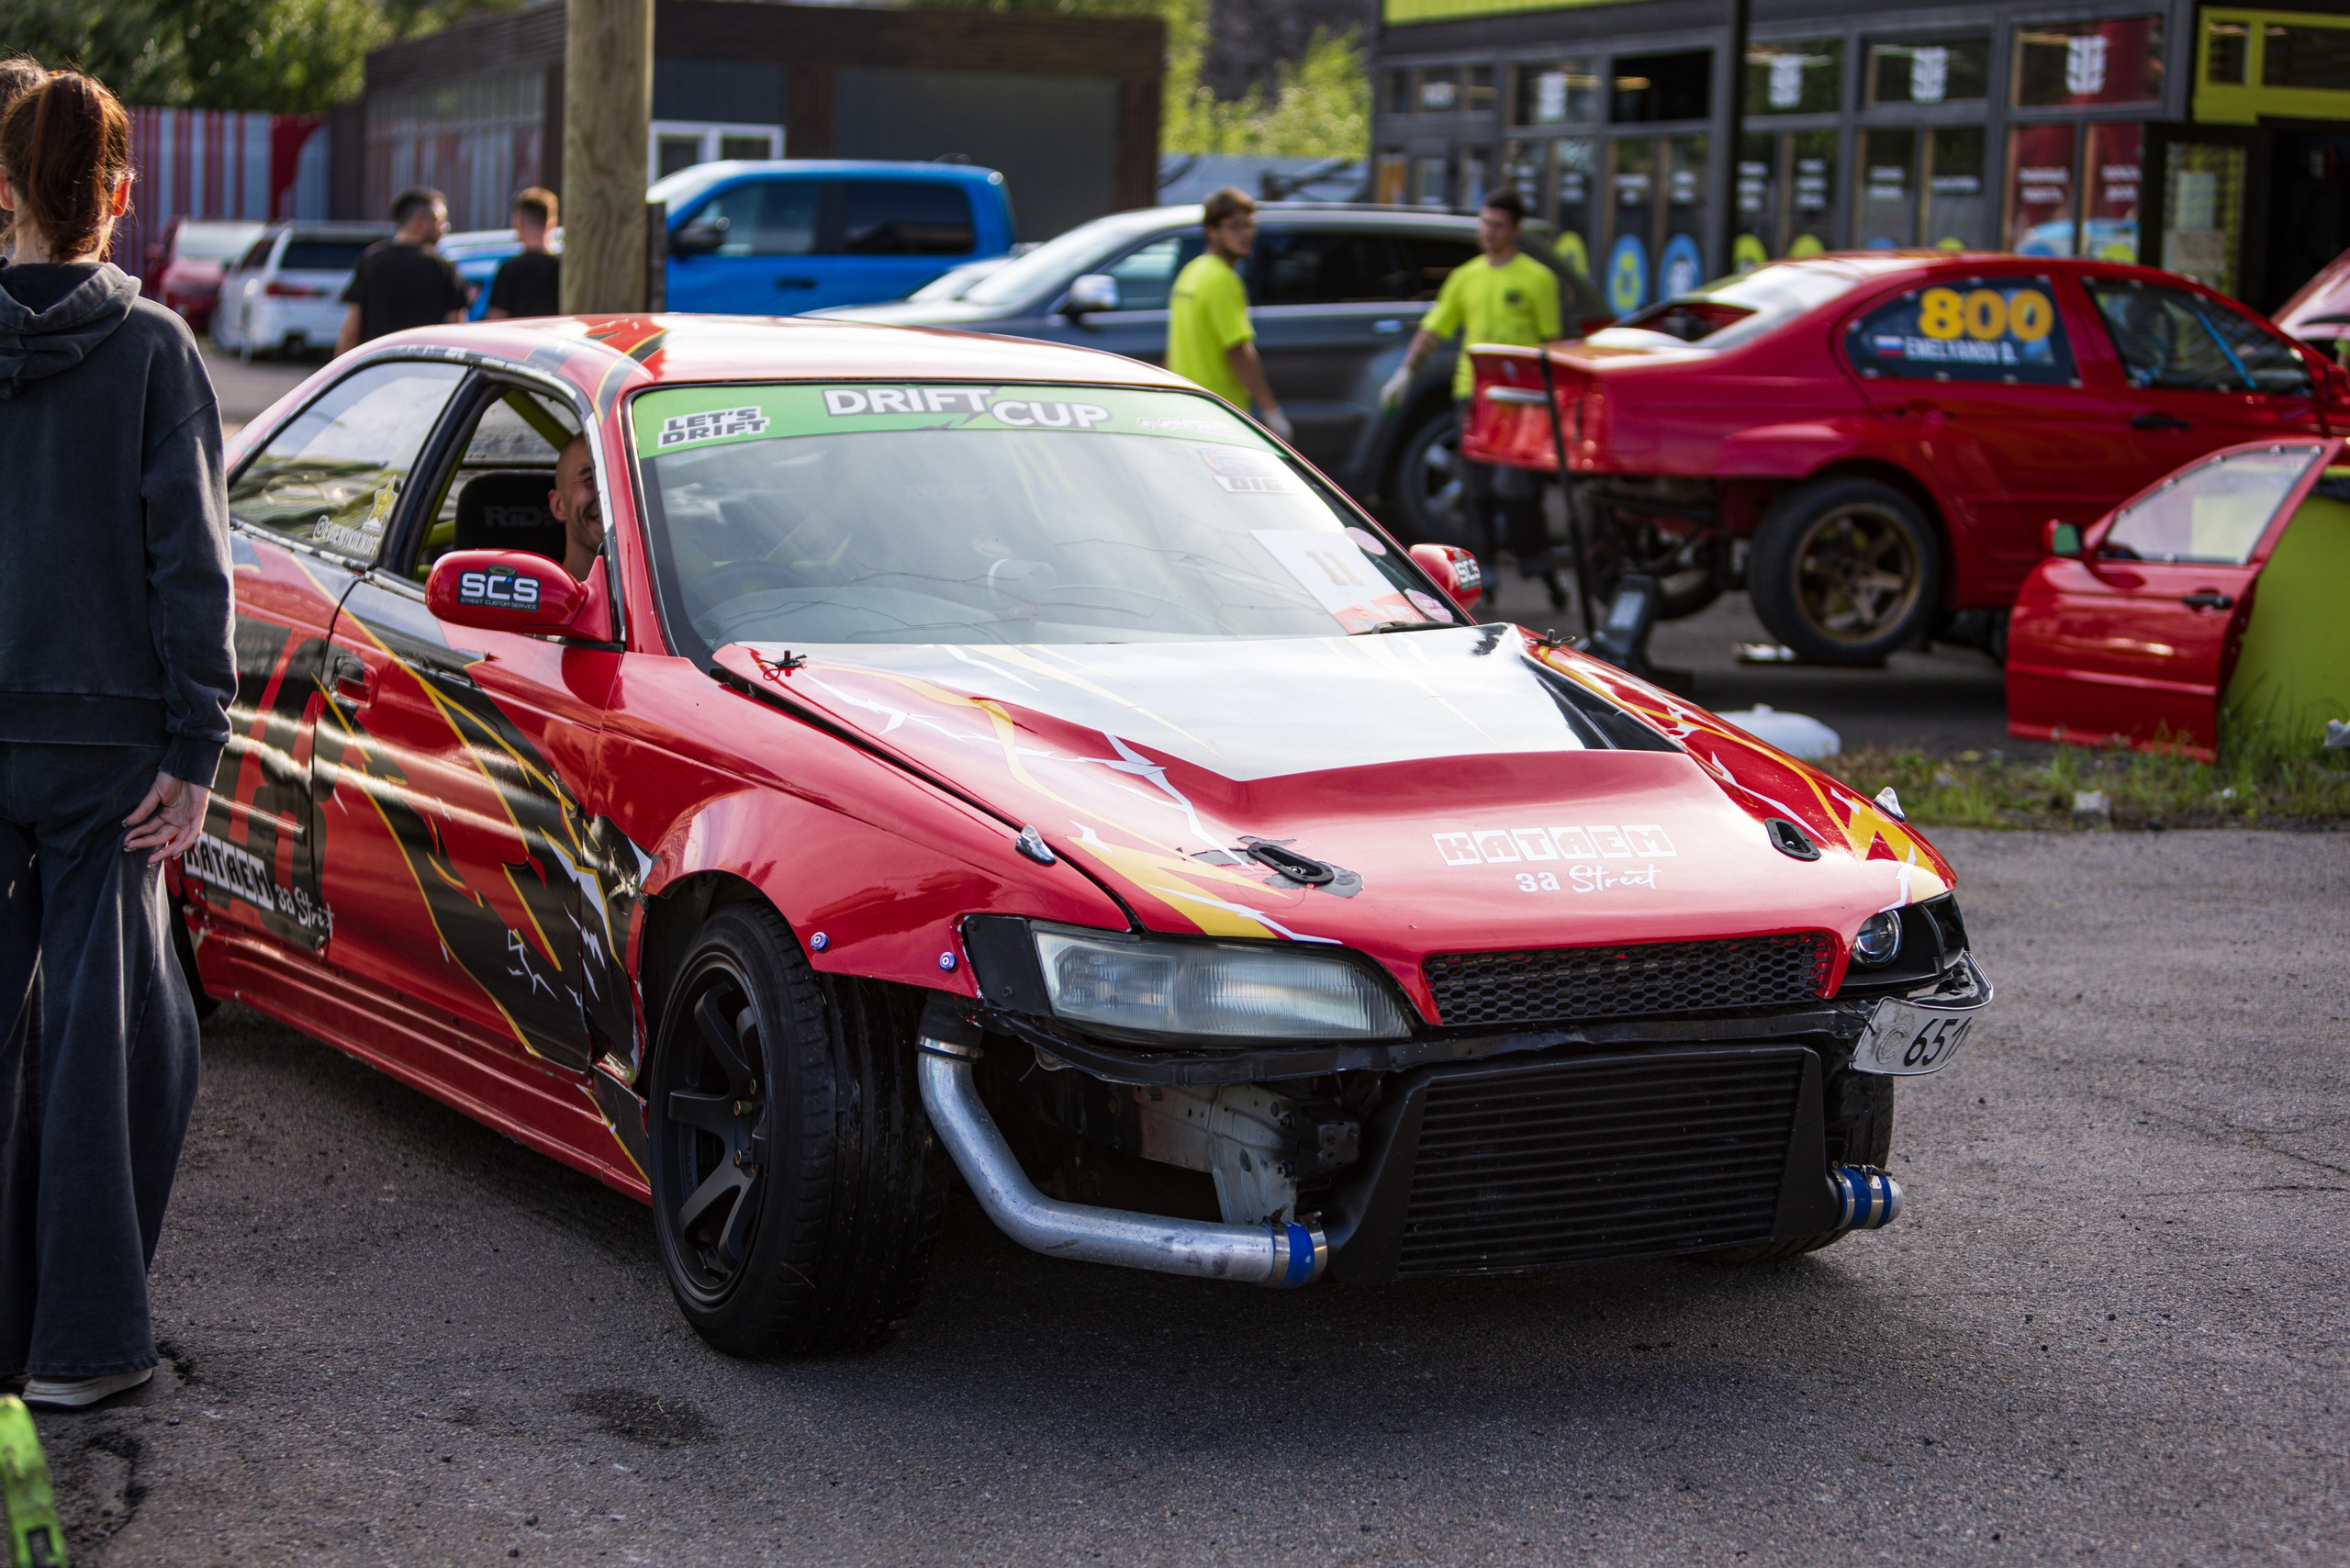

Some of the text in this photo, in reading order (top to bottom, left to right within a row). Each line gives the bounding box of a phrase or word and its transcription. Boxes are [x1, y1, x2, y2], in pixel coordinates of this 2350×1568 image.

[1919, 286, 2054, 342] 800
[667, 408, 758, 431] LET'S
[823, 387, 1108, 428] DRIFT CUP
[662, 419, 767, 445] DRIFT
[1304, 550, 1369, 586] 11
[1455, 558, 1482, 584] SCS
[461, 572, 539, 602] SCS
[510, 601, 537, 610] SERVICE
[1568, 863, 1662, 893] Street
[294, 885, 335, 939] Street
